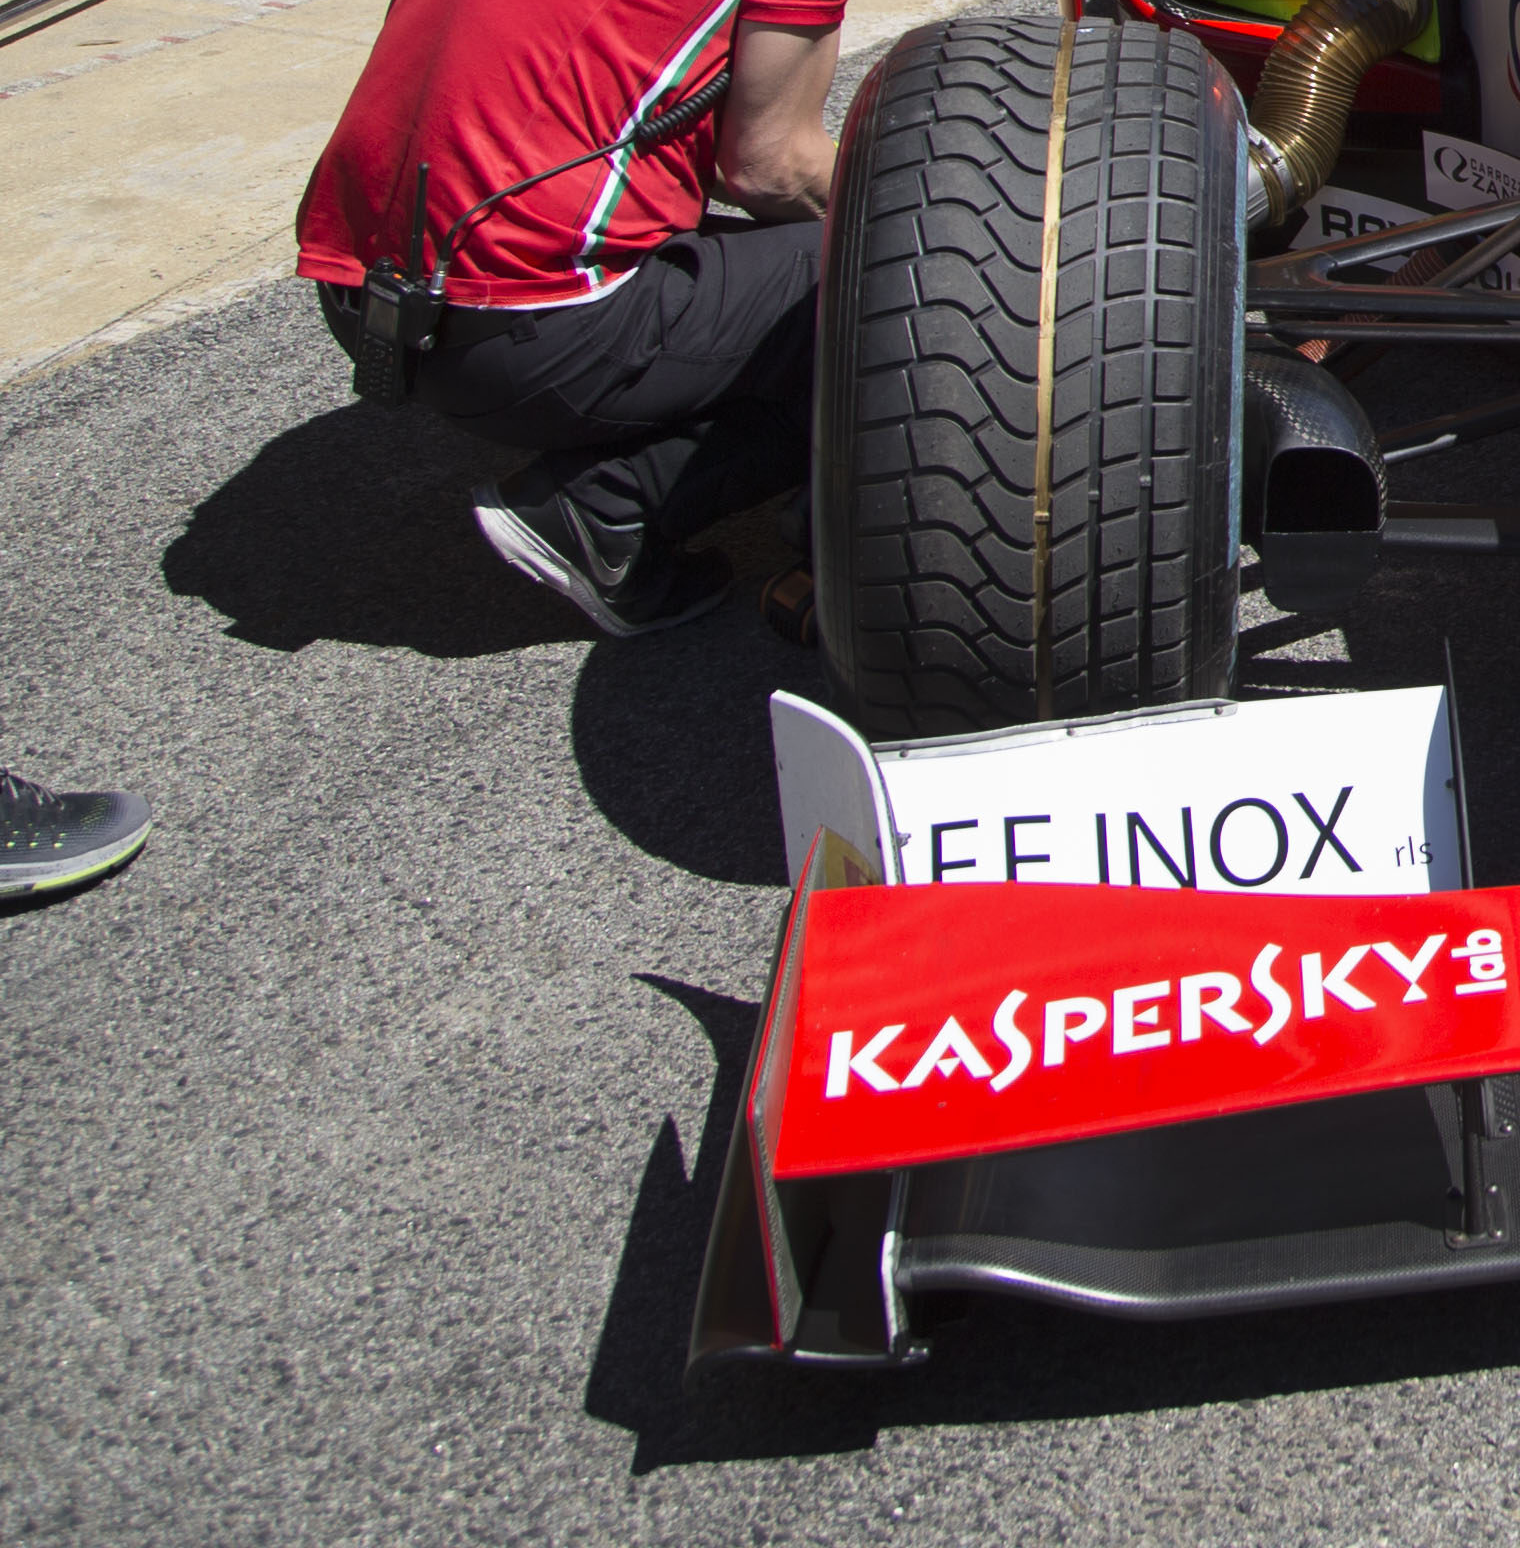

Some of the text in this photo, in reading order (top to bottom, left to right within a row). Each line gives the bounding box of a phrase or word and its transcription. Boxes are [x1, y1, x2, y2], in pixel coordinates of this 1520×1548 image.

[1094, 785, 1365, 889] INOX
[825, 928, 1508, 1100] KASPERSKY lab
